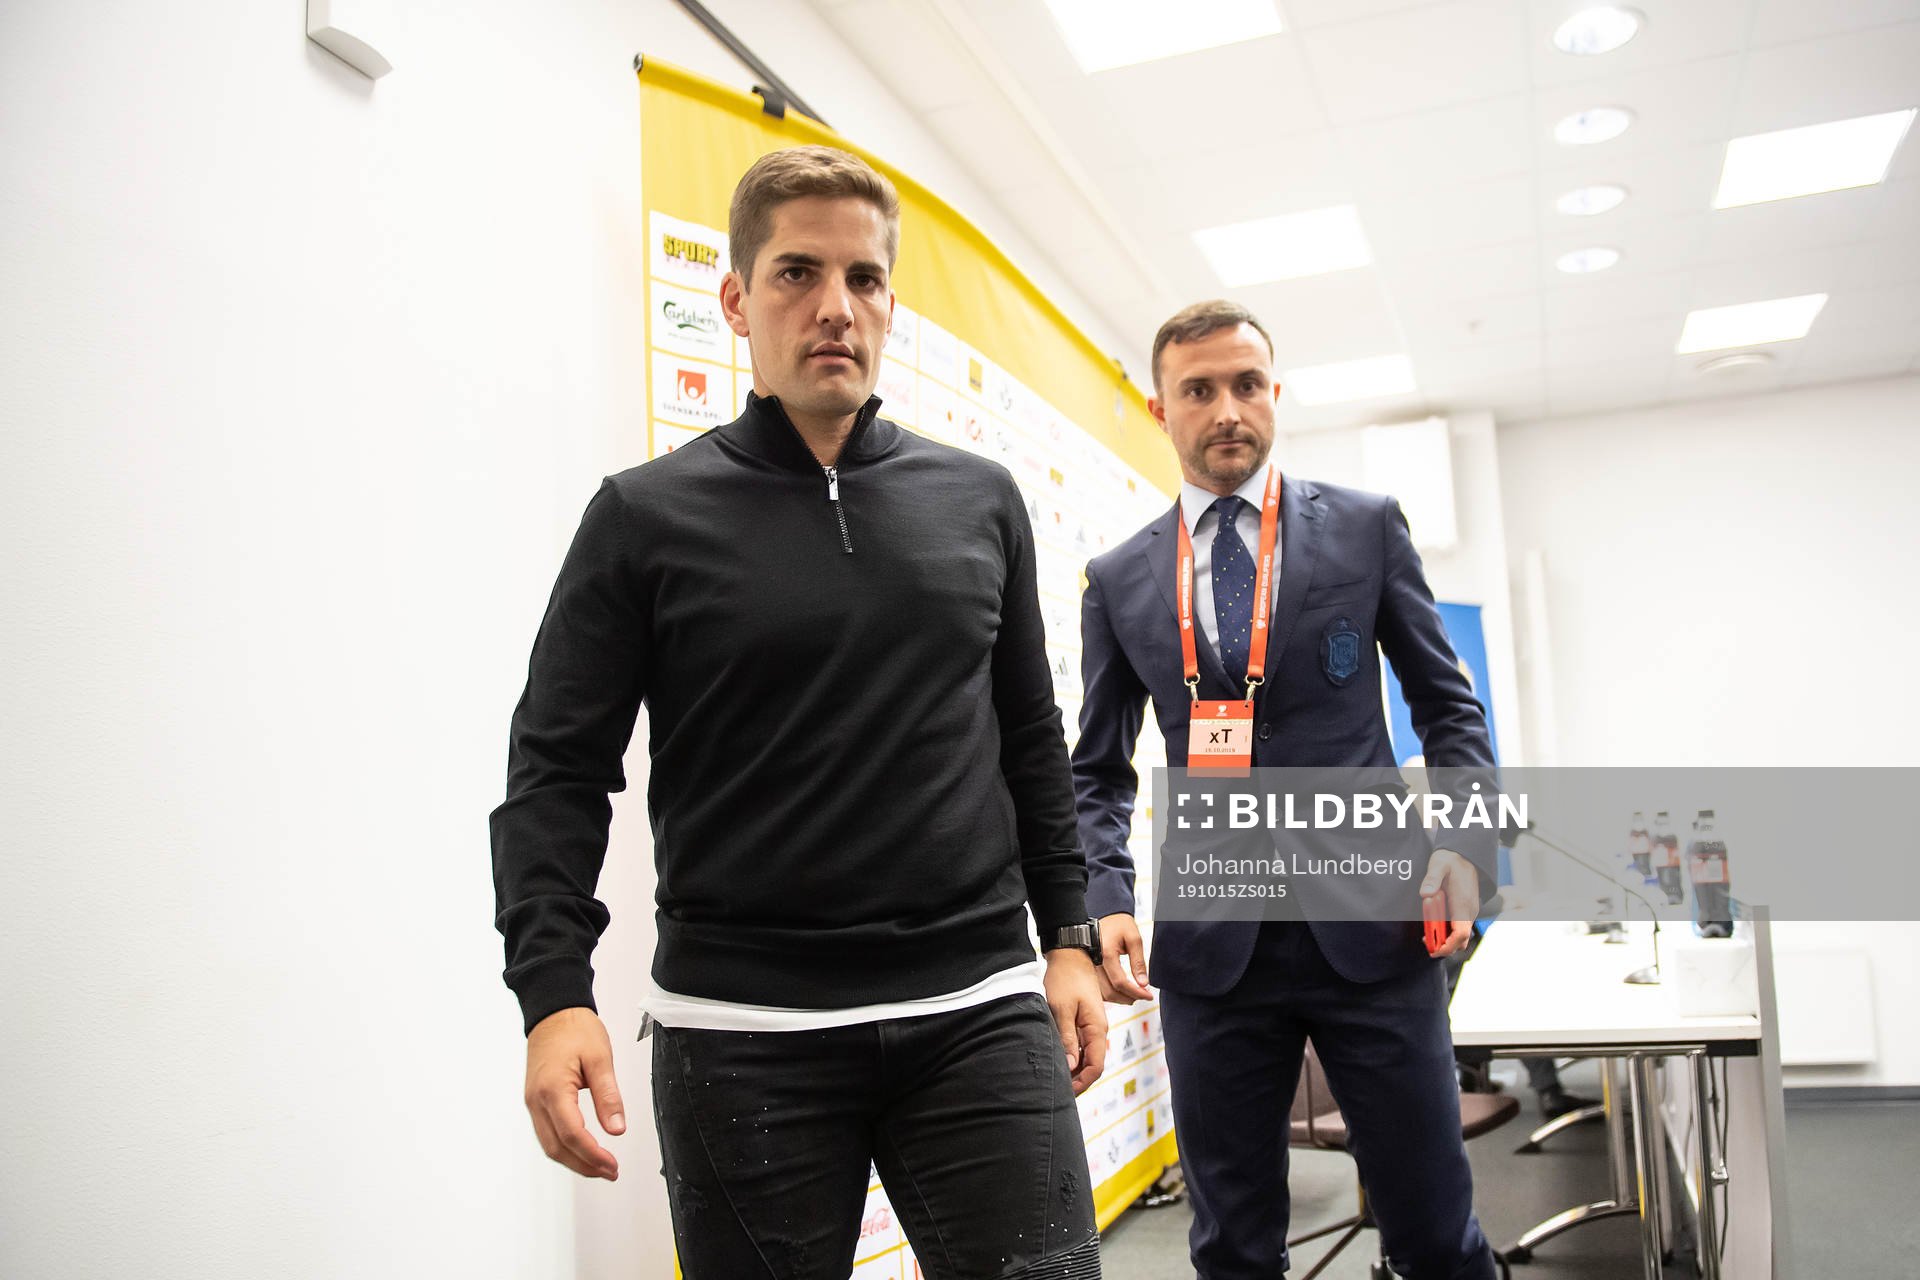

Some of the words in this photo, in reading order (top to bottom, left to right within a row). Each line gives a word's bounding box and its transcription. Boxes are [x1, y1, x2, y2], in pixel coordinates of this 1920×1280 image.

[663, 233, 718, 269] SPORT
[663, 301, 719, 333] Carlsberg
[1209, 728, 1233, 744] xT
